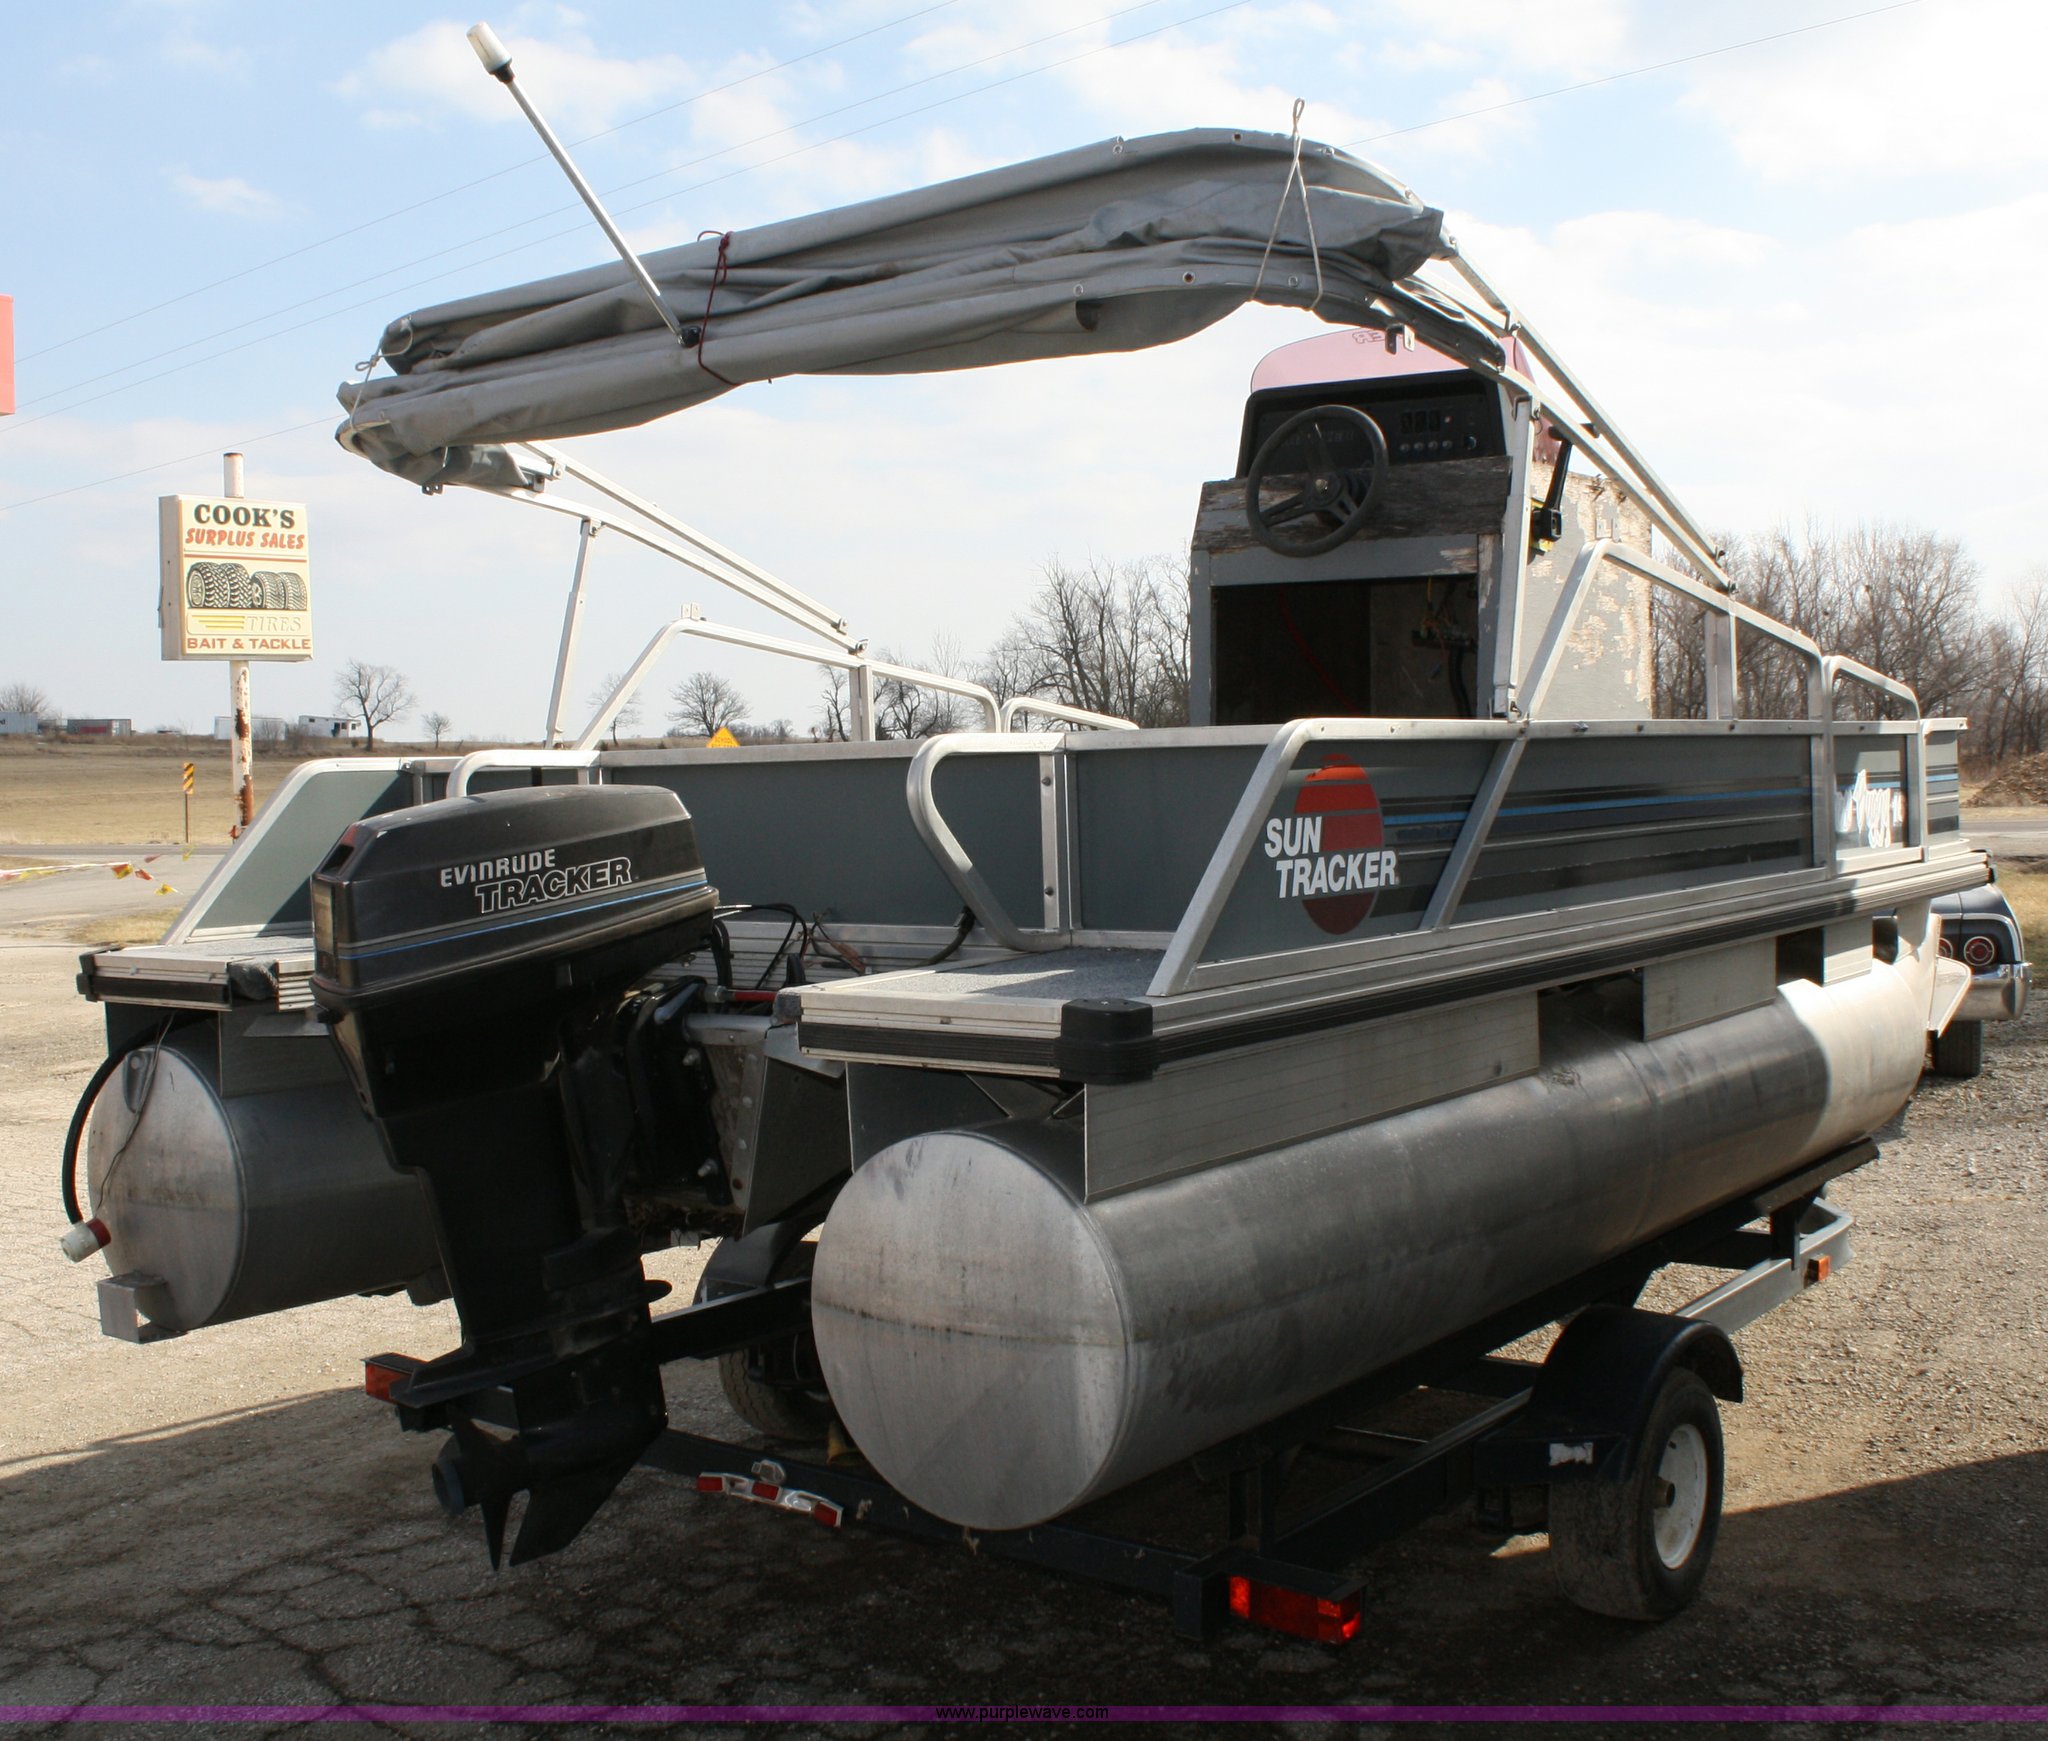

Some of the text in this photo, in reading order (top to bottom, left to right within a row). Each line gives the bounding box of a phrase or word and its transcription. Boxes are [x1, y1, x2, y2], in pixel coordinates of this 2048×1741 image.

[194, 504, 295, 529] COOK'S
[185, 528, 305, 549] SURPLUS SALES
[247, 616, 302, 632] TIRES
[187, 638, 311, 650] BAIT & TACKLE
[1264, 816, 1322, 858] SUN
[441, 849, 556, 887] EVINRUDE
[1275, 850, 1397, 898] TRACKER
[475, 857, 632, 914] TRACKER
